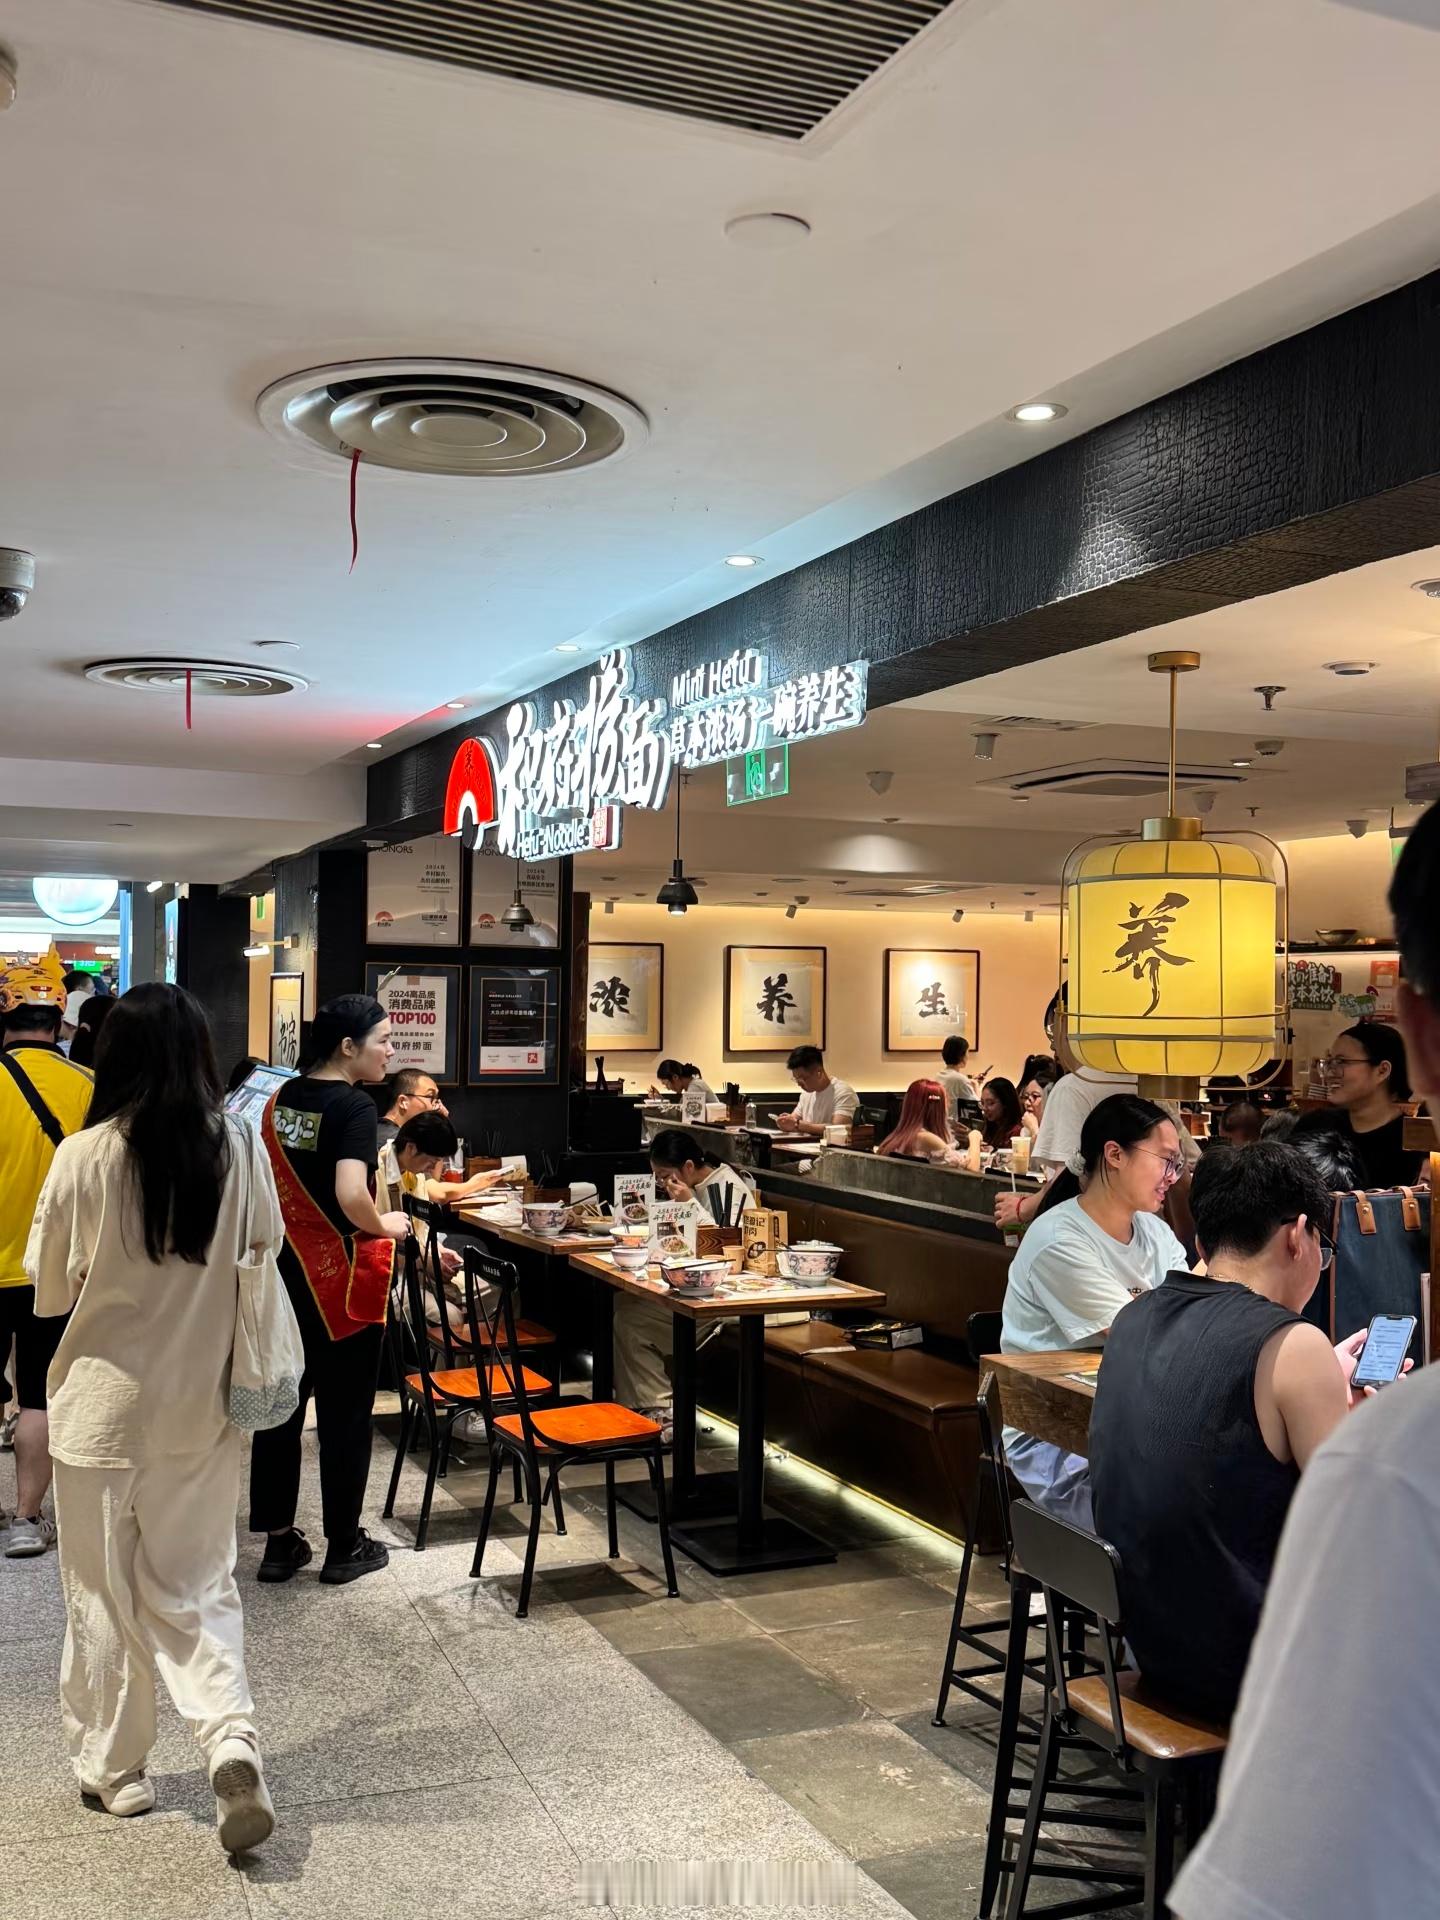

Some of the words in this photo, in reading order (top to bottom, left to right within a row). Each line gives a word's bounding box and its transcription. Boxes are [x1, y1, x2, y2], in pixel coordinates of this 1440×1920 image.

[709, 650, 757, 699] Hefu
[499, 648, 666, 857] 和府捞面
[1102, 892, 1196, 1017] 养
[388, 990, 436, 999] 2024高品质
[388, 999, 436, 1011] 消费品牌
[756, 973, 796, 1024] 养
[915, 982, 950, 1018] 生
[388, 1012, 436, 1025] TOP100
